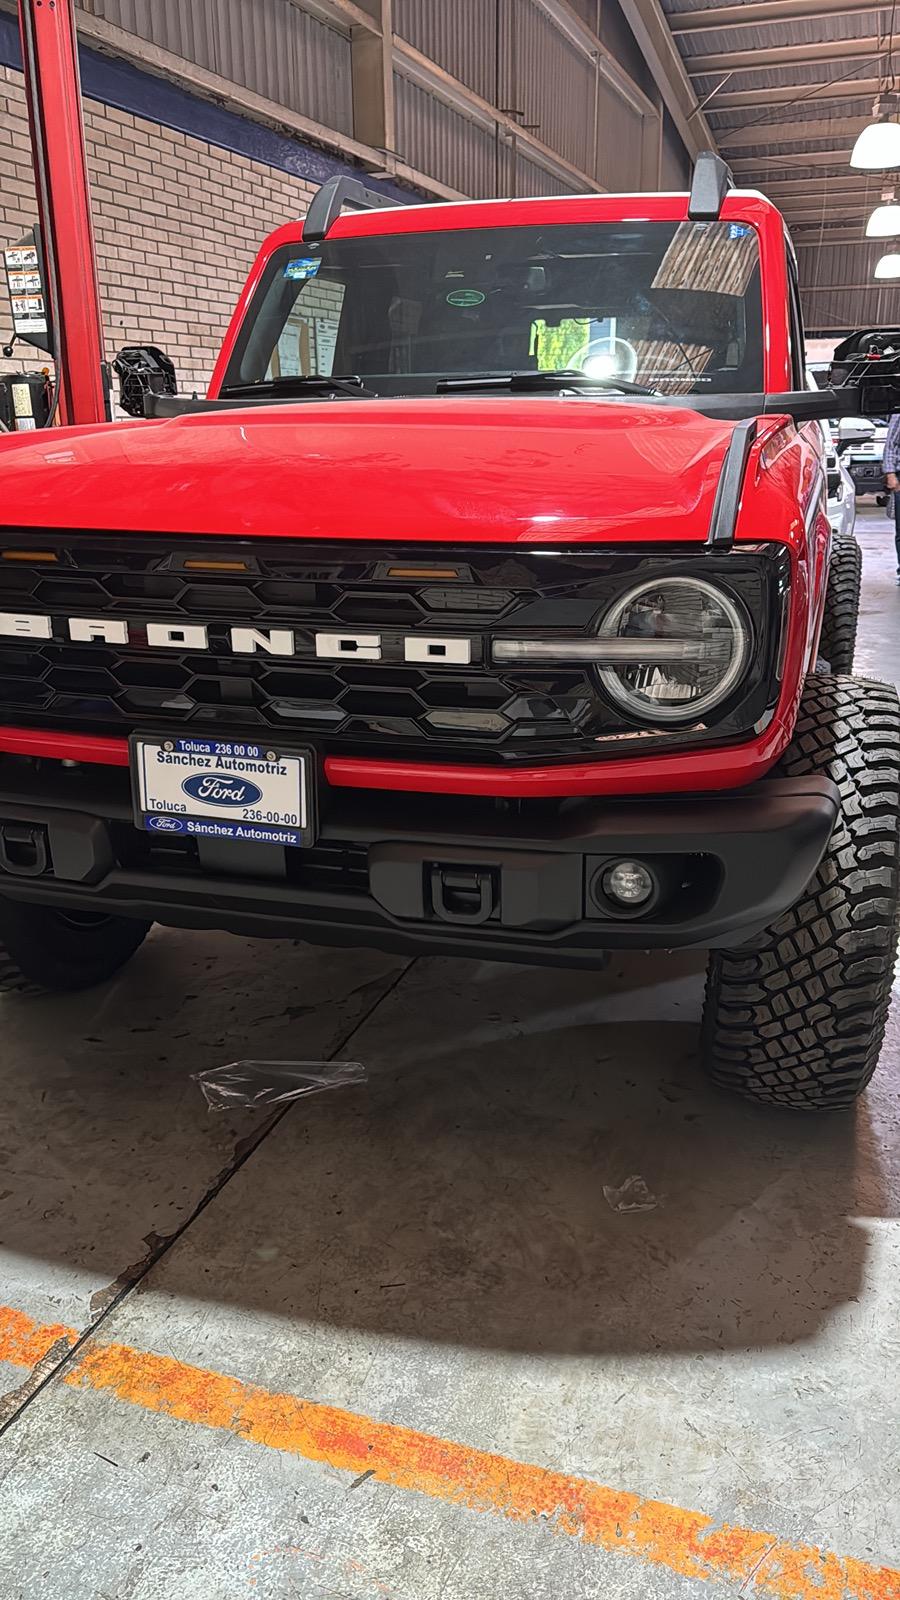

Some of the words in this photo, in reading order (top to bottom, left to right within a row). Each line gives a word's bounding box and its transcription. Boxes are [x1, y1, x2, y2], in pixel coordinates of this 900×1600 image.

[0, 612, 471, 664] BRONCO
[179, 740, 211, 753] Toluca
[215, 743, 233, 754] 236
[234, 744, 245, 756] 00
[248, 746, 259, 757] 00
[157, 751, 211, 768] Sánchez
[215, 756, 288, 776] Automotriz
[197, 776, 246, 801] Ford
[149, 798, 187, 813] Toluca
[156, 817, 176, 829] Ford
[242, 808, 298, 825] 236-00-00
[187, 820, 234, 836] Sánchez
[236, 828, 297, 843] Automotriz
